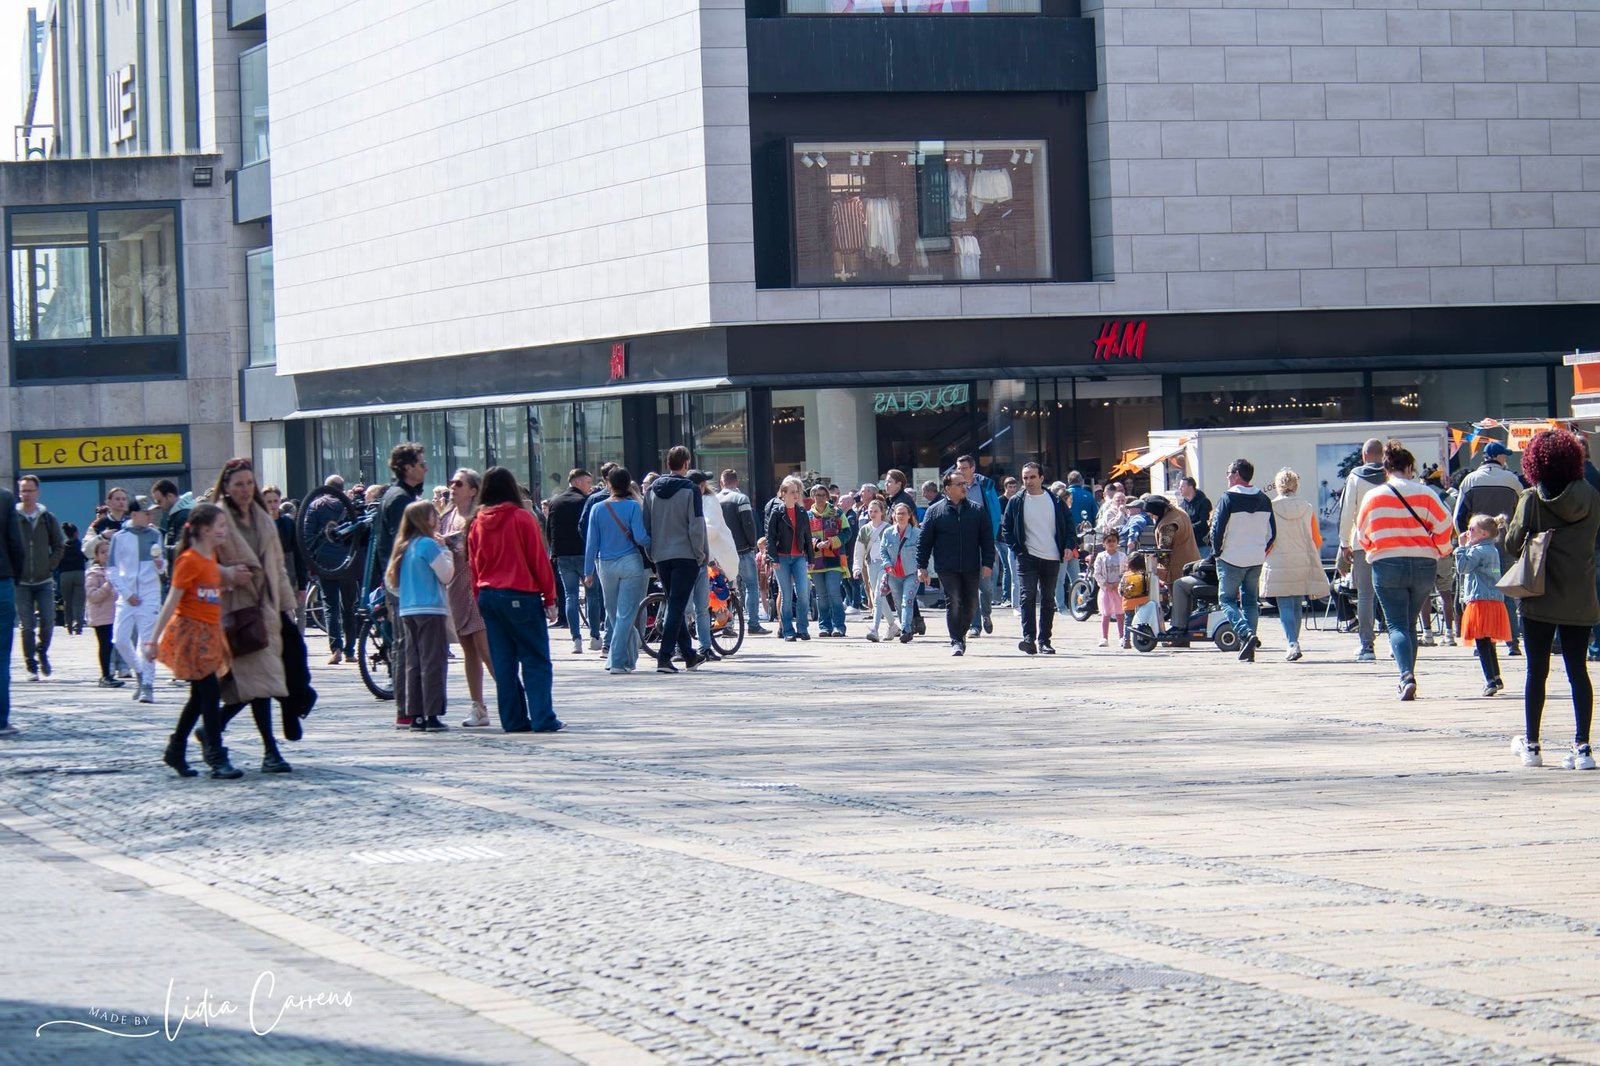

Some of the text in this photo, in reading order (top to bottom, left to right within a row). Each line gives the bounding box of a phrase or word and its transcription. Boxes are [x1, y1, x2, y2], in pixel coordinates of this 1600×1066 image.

[1095, 320, 1147, 360] H&M
[33, 438, 168, 465] Le Gaufra
